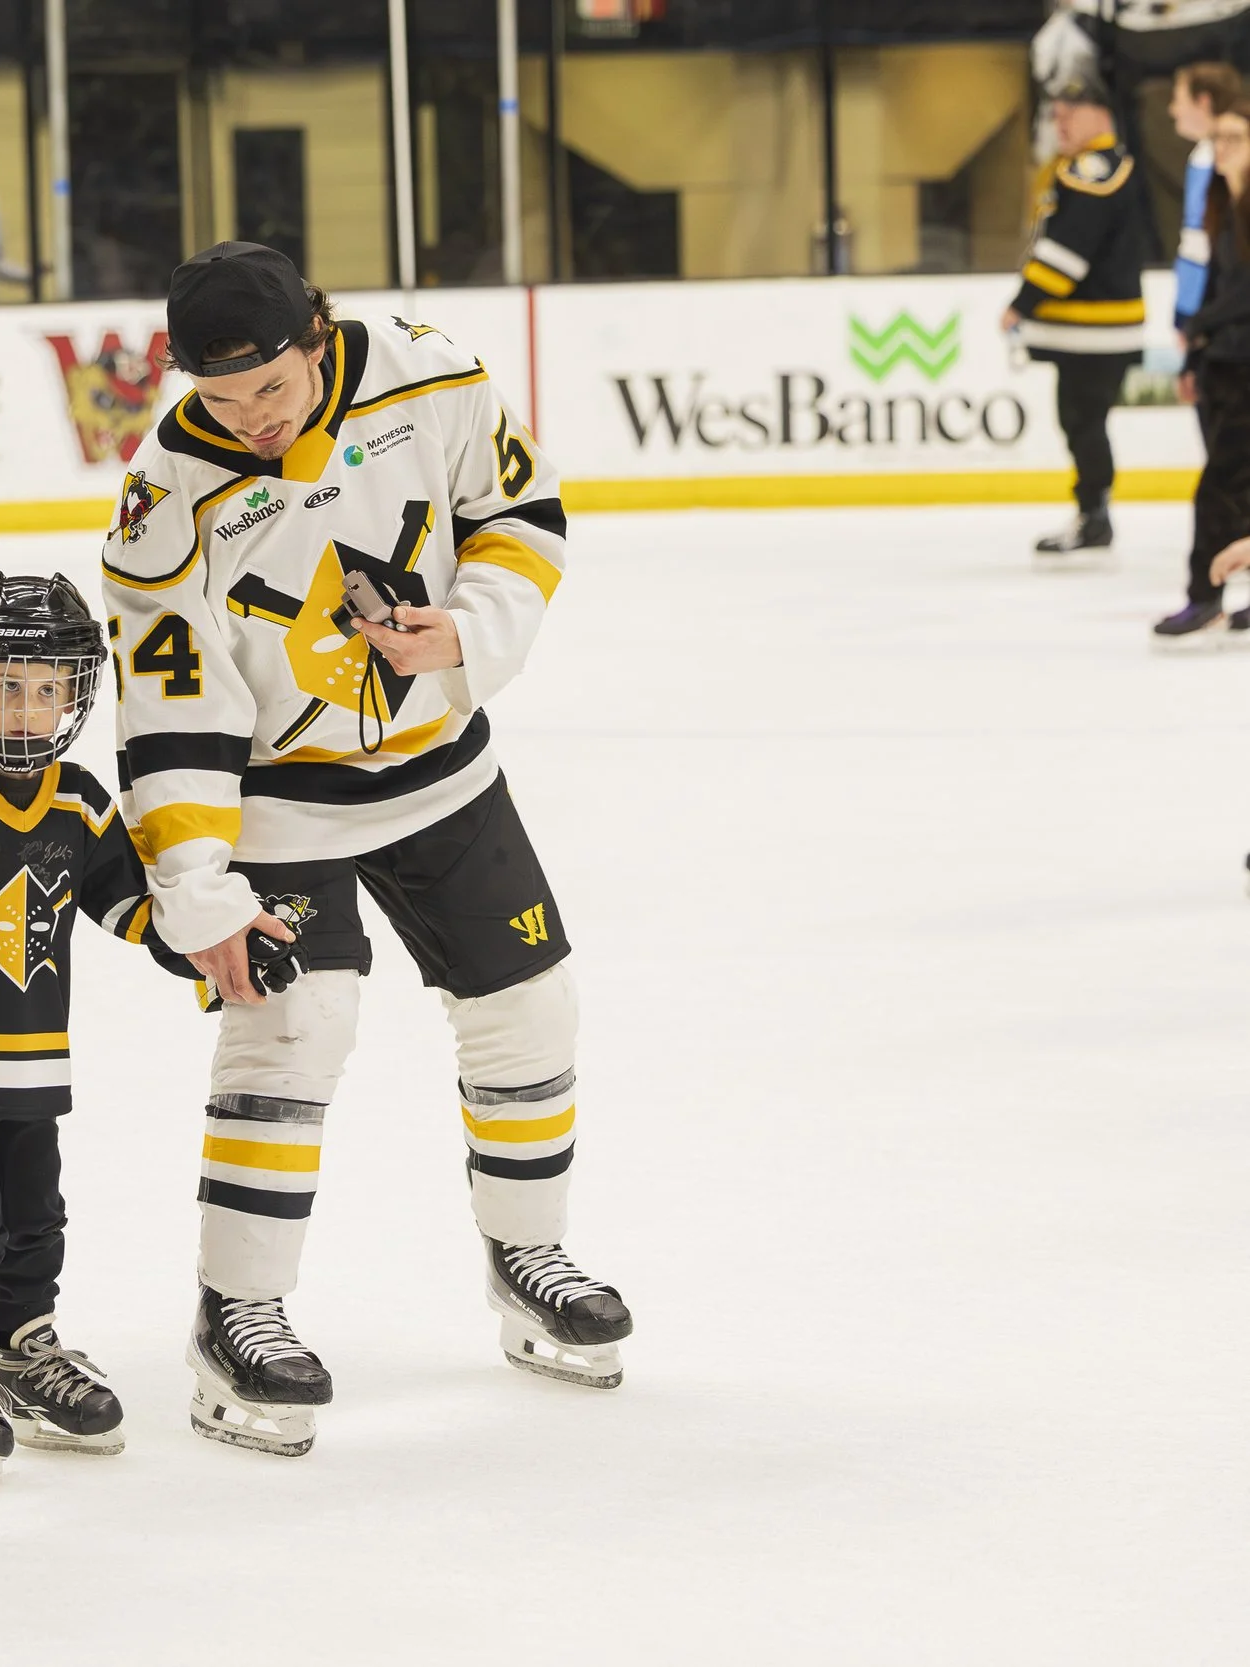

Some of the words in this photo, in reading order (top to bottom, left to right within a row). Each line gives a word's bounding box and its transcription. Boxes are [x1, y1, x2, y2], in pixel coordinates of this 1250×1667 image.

[609, 370, 1029, 452] WesBanco
[366, 423, 415, 451] MATHESON
[214, 498, 286, 542] WesBanco
[211, 1342, 236, 1378] BAUER
